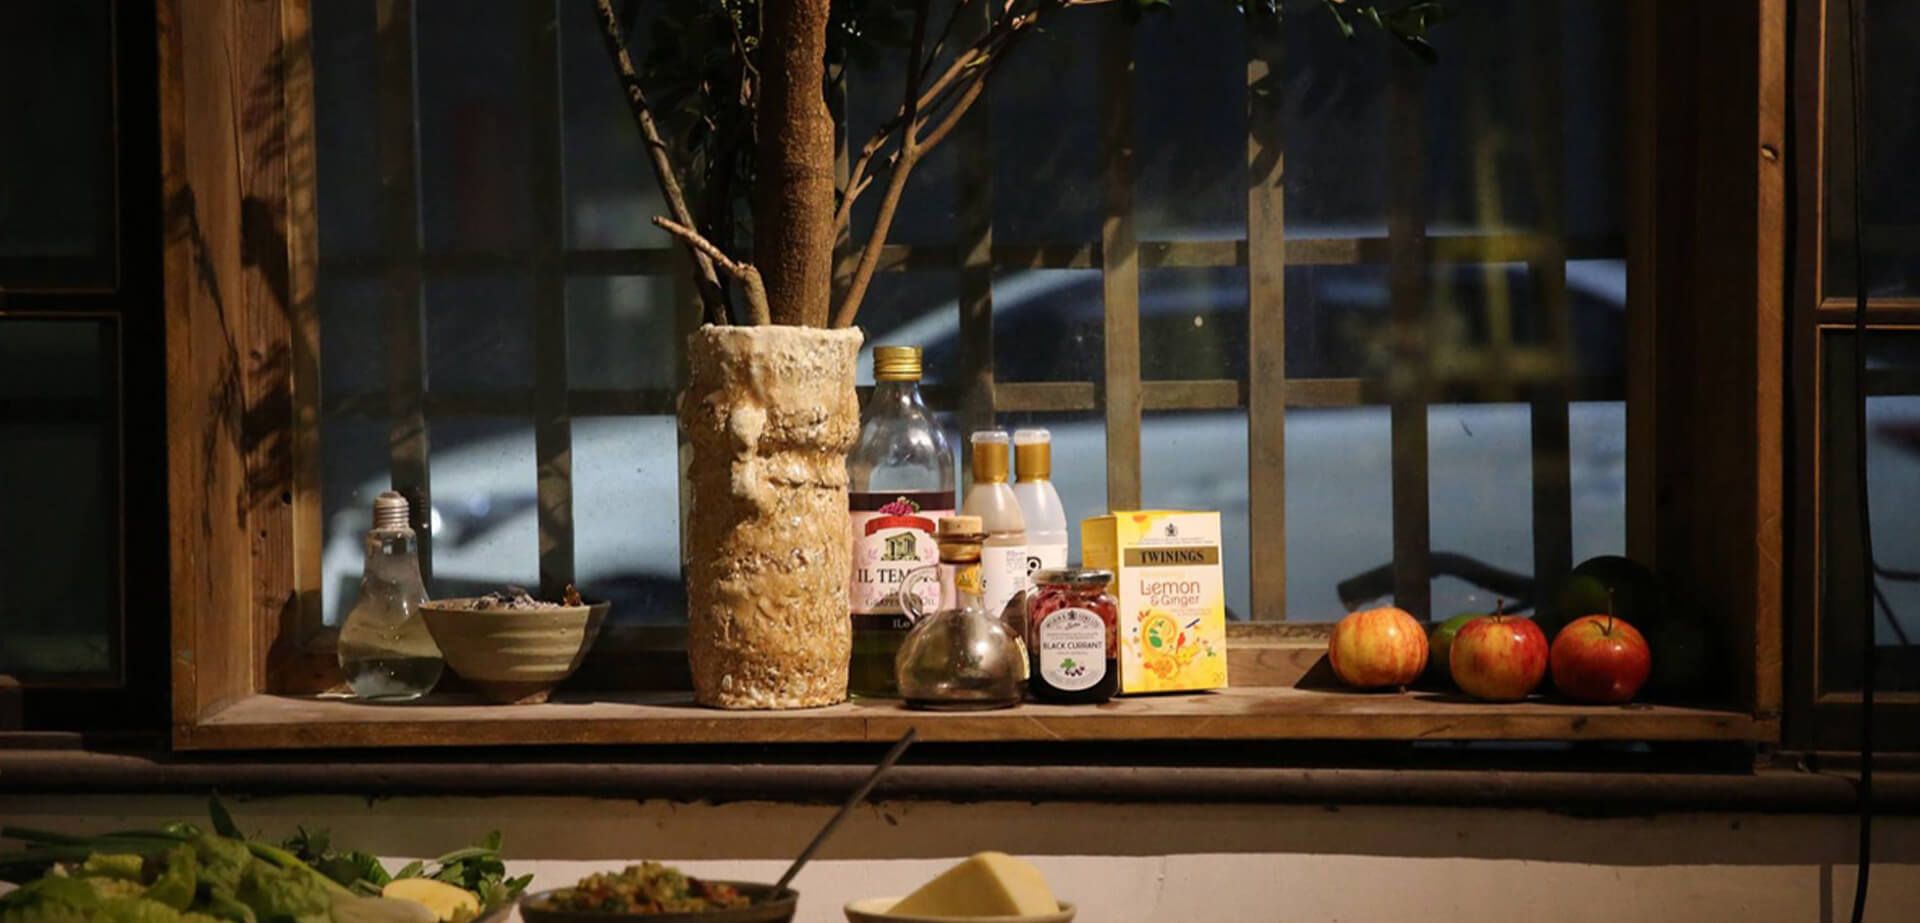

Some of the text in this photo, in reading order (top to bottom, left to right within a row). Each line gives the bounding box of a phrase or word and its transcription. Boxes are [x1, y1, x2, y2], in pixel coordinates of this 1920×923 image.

[1140, 551, 1204, 564] TWININGS
[858, 569, 873, 583] IL
[1140, 580, 1200, 596] Lemon
[1150, 595, 1199, 607] & Ginger
